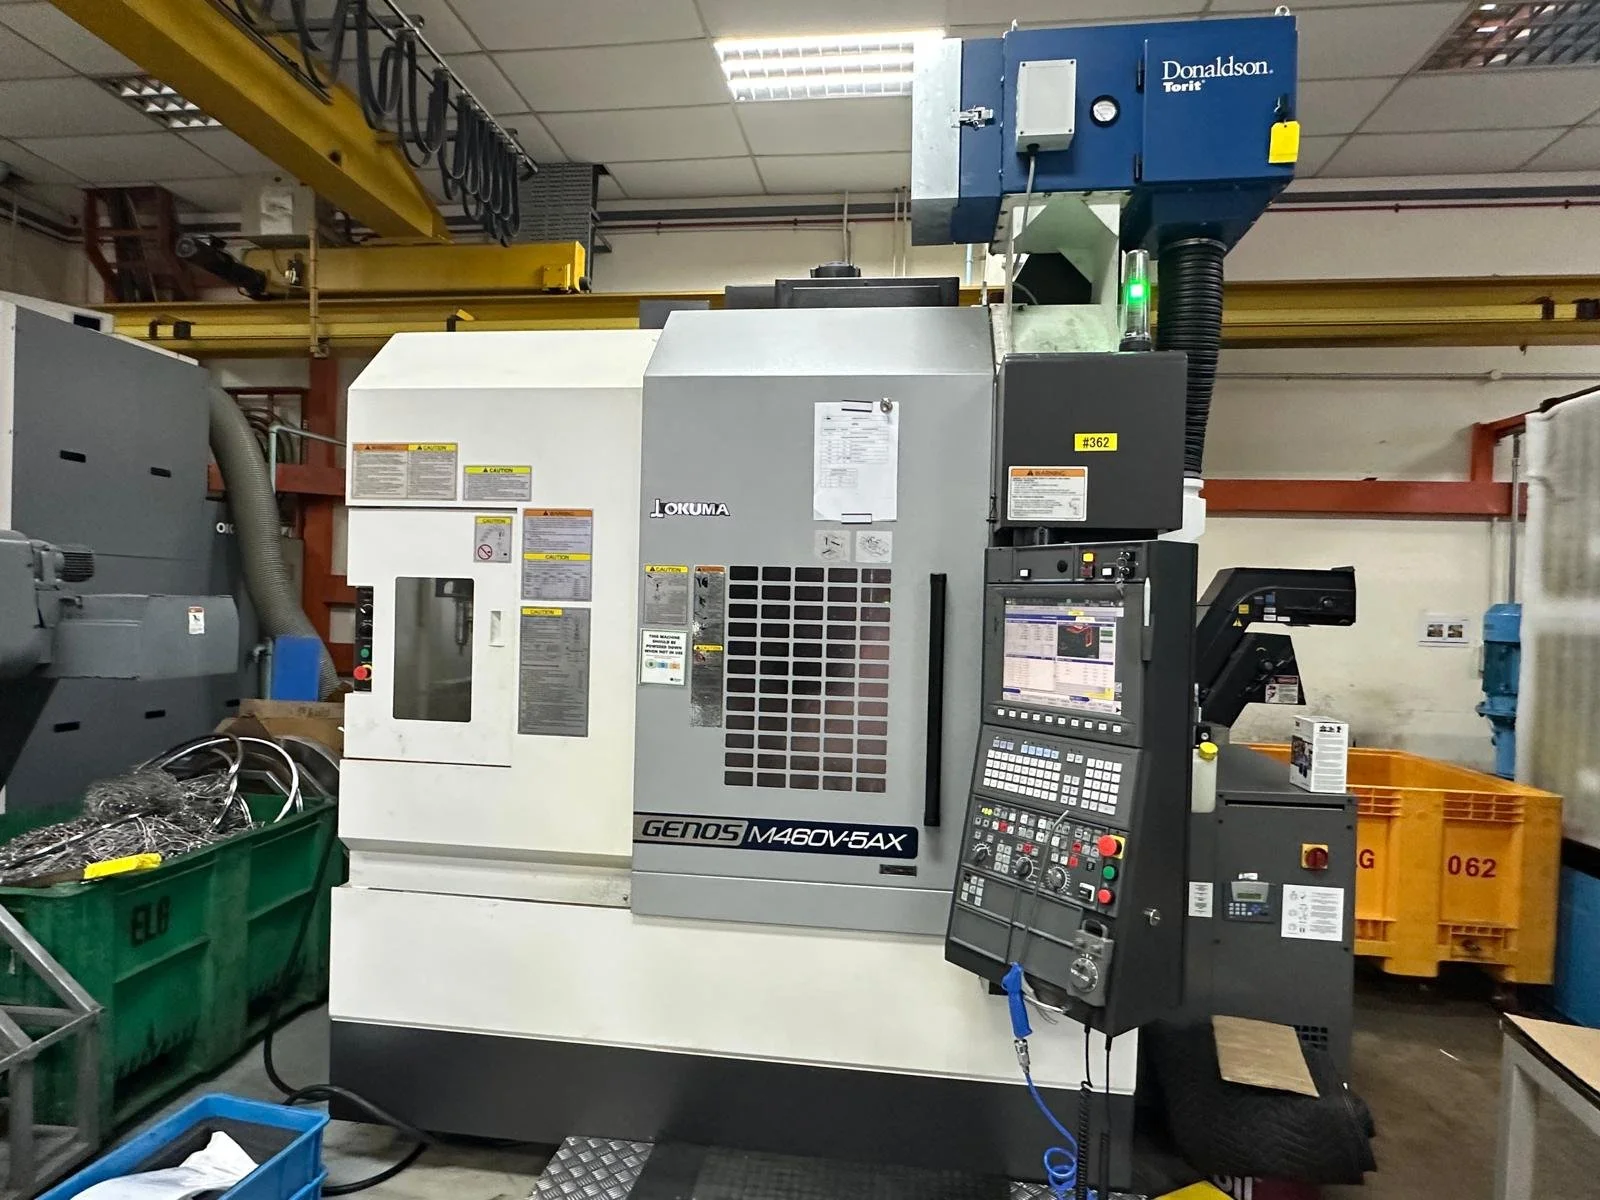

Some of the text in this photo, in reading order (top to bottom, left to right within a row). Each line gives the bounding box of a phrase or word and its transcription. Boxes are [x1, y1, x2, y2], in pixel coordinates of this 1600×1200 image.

[1162, 80, 1202, 93] Torit
[1082, 436, 1110, 449] #362
[664, 501, 730, 516] OKUMA
[641, 820, 909, 851] GENOS M460V-5AX
[1356, 848, 1497, 878] G 062
